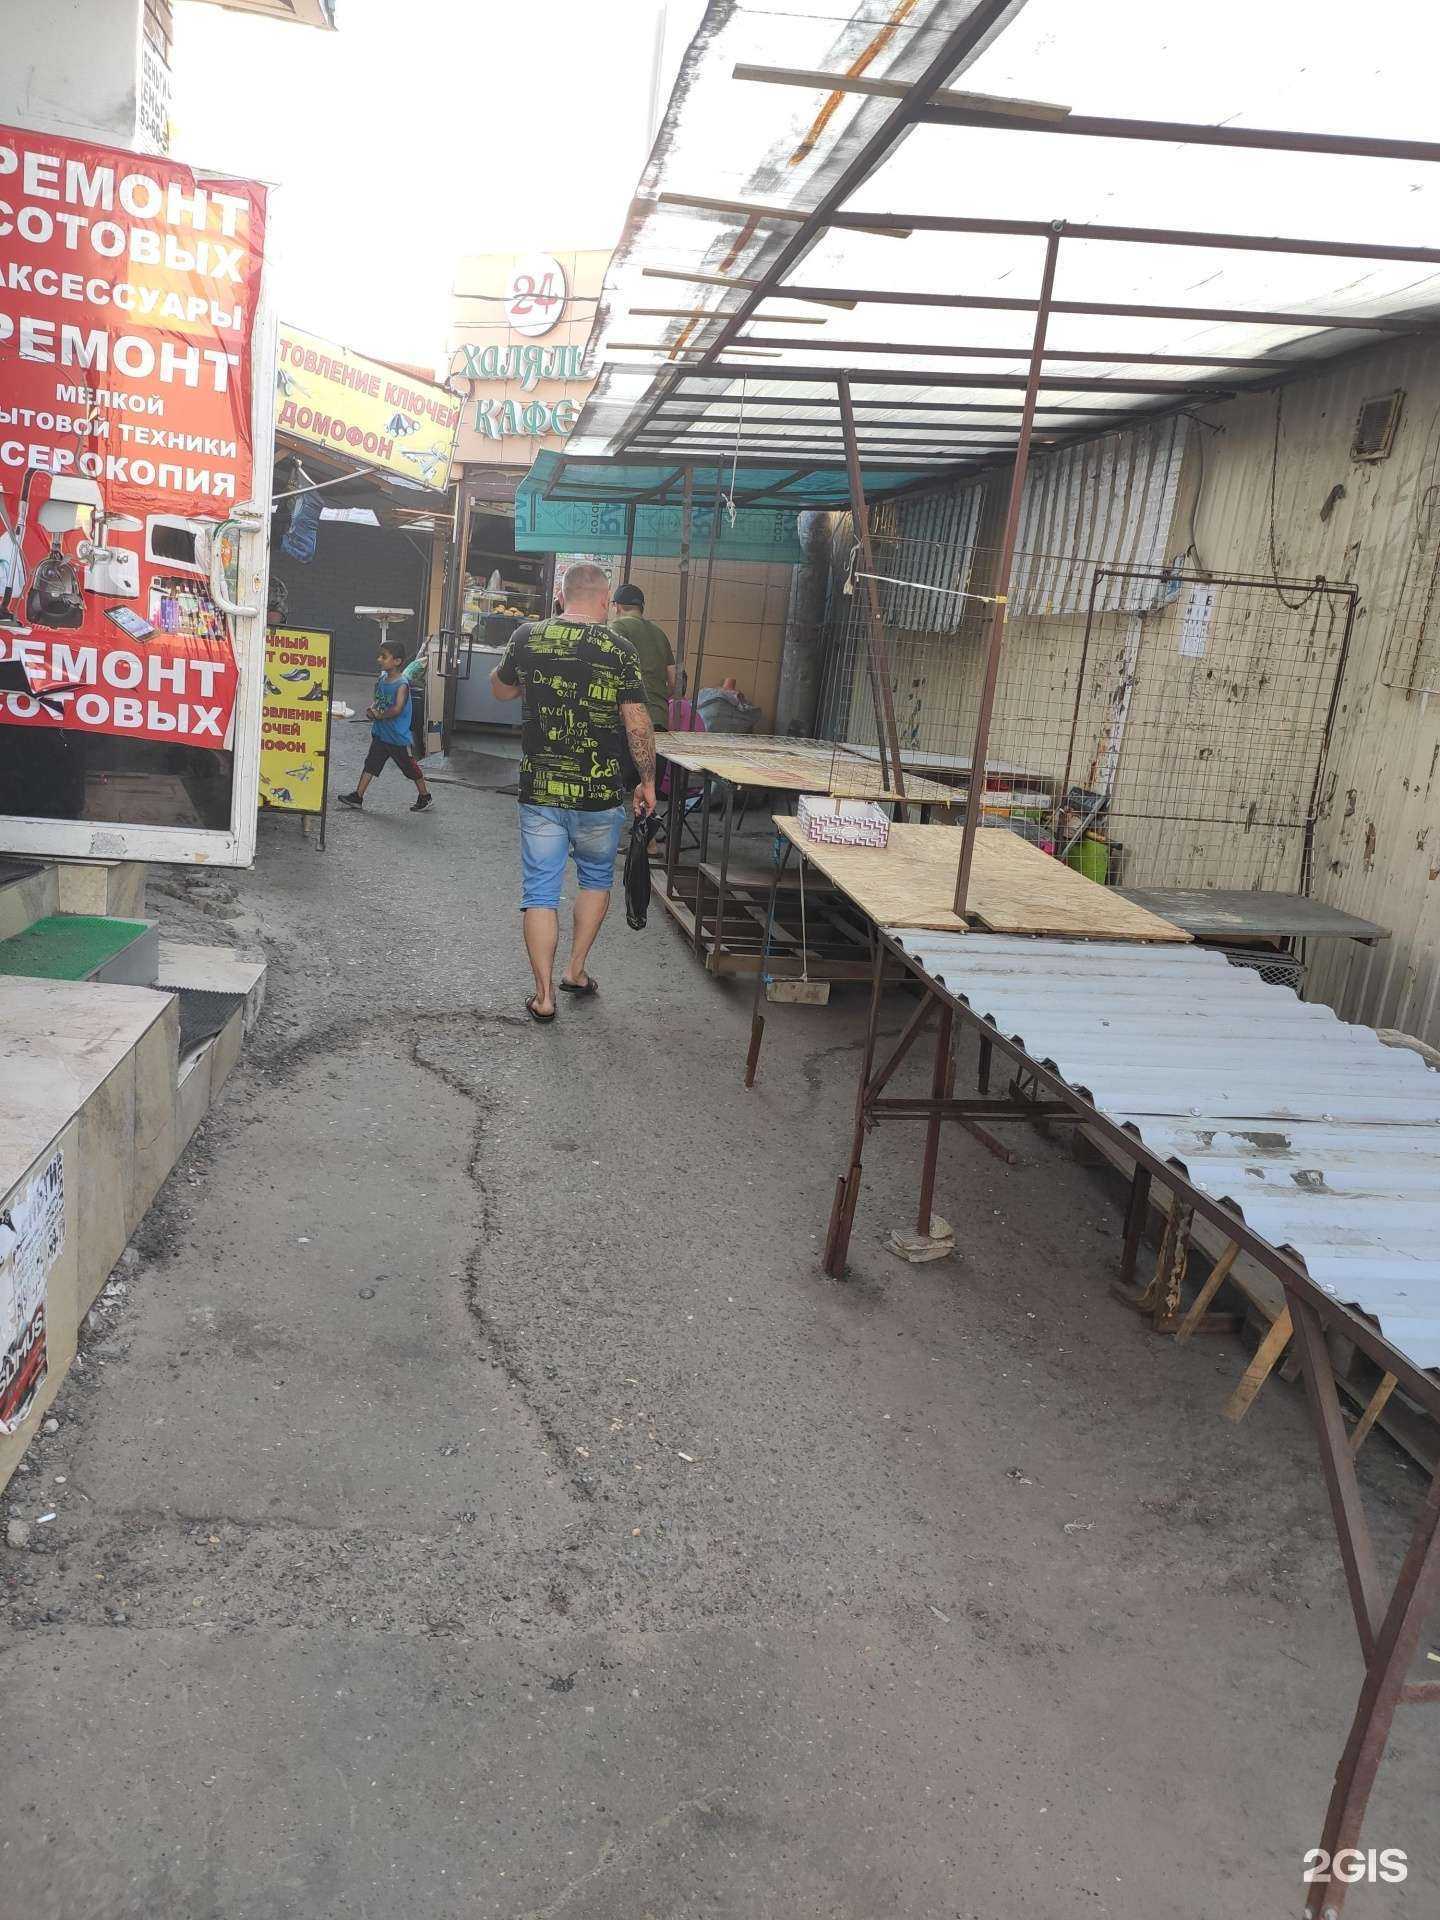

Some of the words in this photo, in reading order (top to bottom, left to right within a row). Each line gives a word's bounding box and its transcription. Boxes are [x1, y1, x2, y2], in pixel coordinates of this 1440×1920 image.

[0, 146, 249, 237] РЕМОНТ
[0, 262, 242, 331] КСЕССУАРЫ
[510, 272, 558, 315] 24
[55, 383, 164, 416] МЕЛКОЙ
[279, 339, 382, 398] ТОВЛЕНИЕ
[384, 382, 459, 430] КЛЮЧЕЙ
[278, 401, 394, 460] ДОМОФОН
[474, 399, 575, 439] КАФЕ
[118, 423, 237, 459] ТЕХНИКИ
[0, 440, 235, 498] СЕРОКОПИЯ
[264, 651, 276, 663] Т
[279, 652, 326, 668] ОБУВИ
[265, 635, 309, 650] ЧНЫЙ
[0, 637, 225, 698] ЕМОНТ
[0, 691, 223, 737] ОТОВЫХ
[262, 706, 322, 722] ОВЛЕНИЕ
[262, 722, 301, 736] ОЧЕЙ
[261, 738, 306, 753] ОФОН
